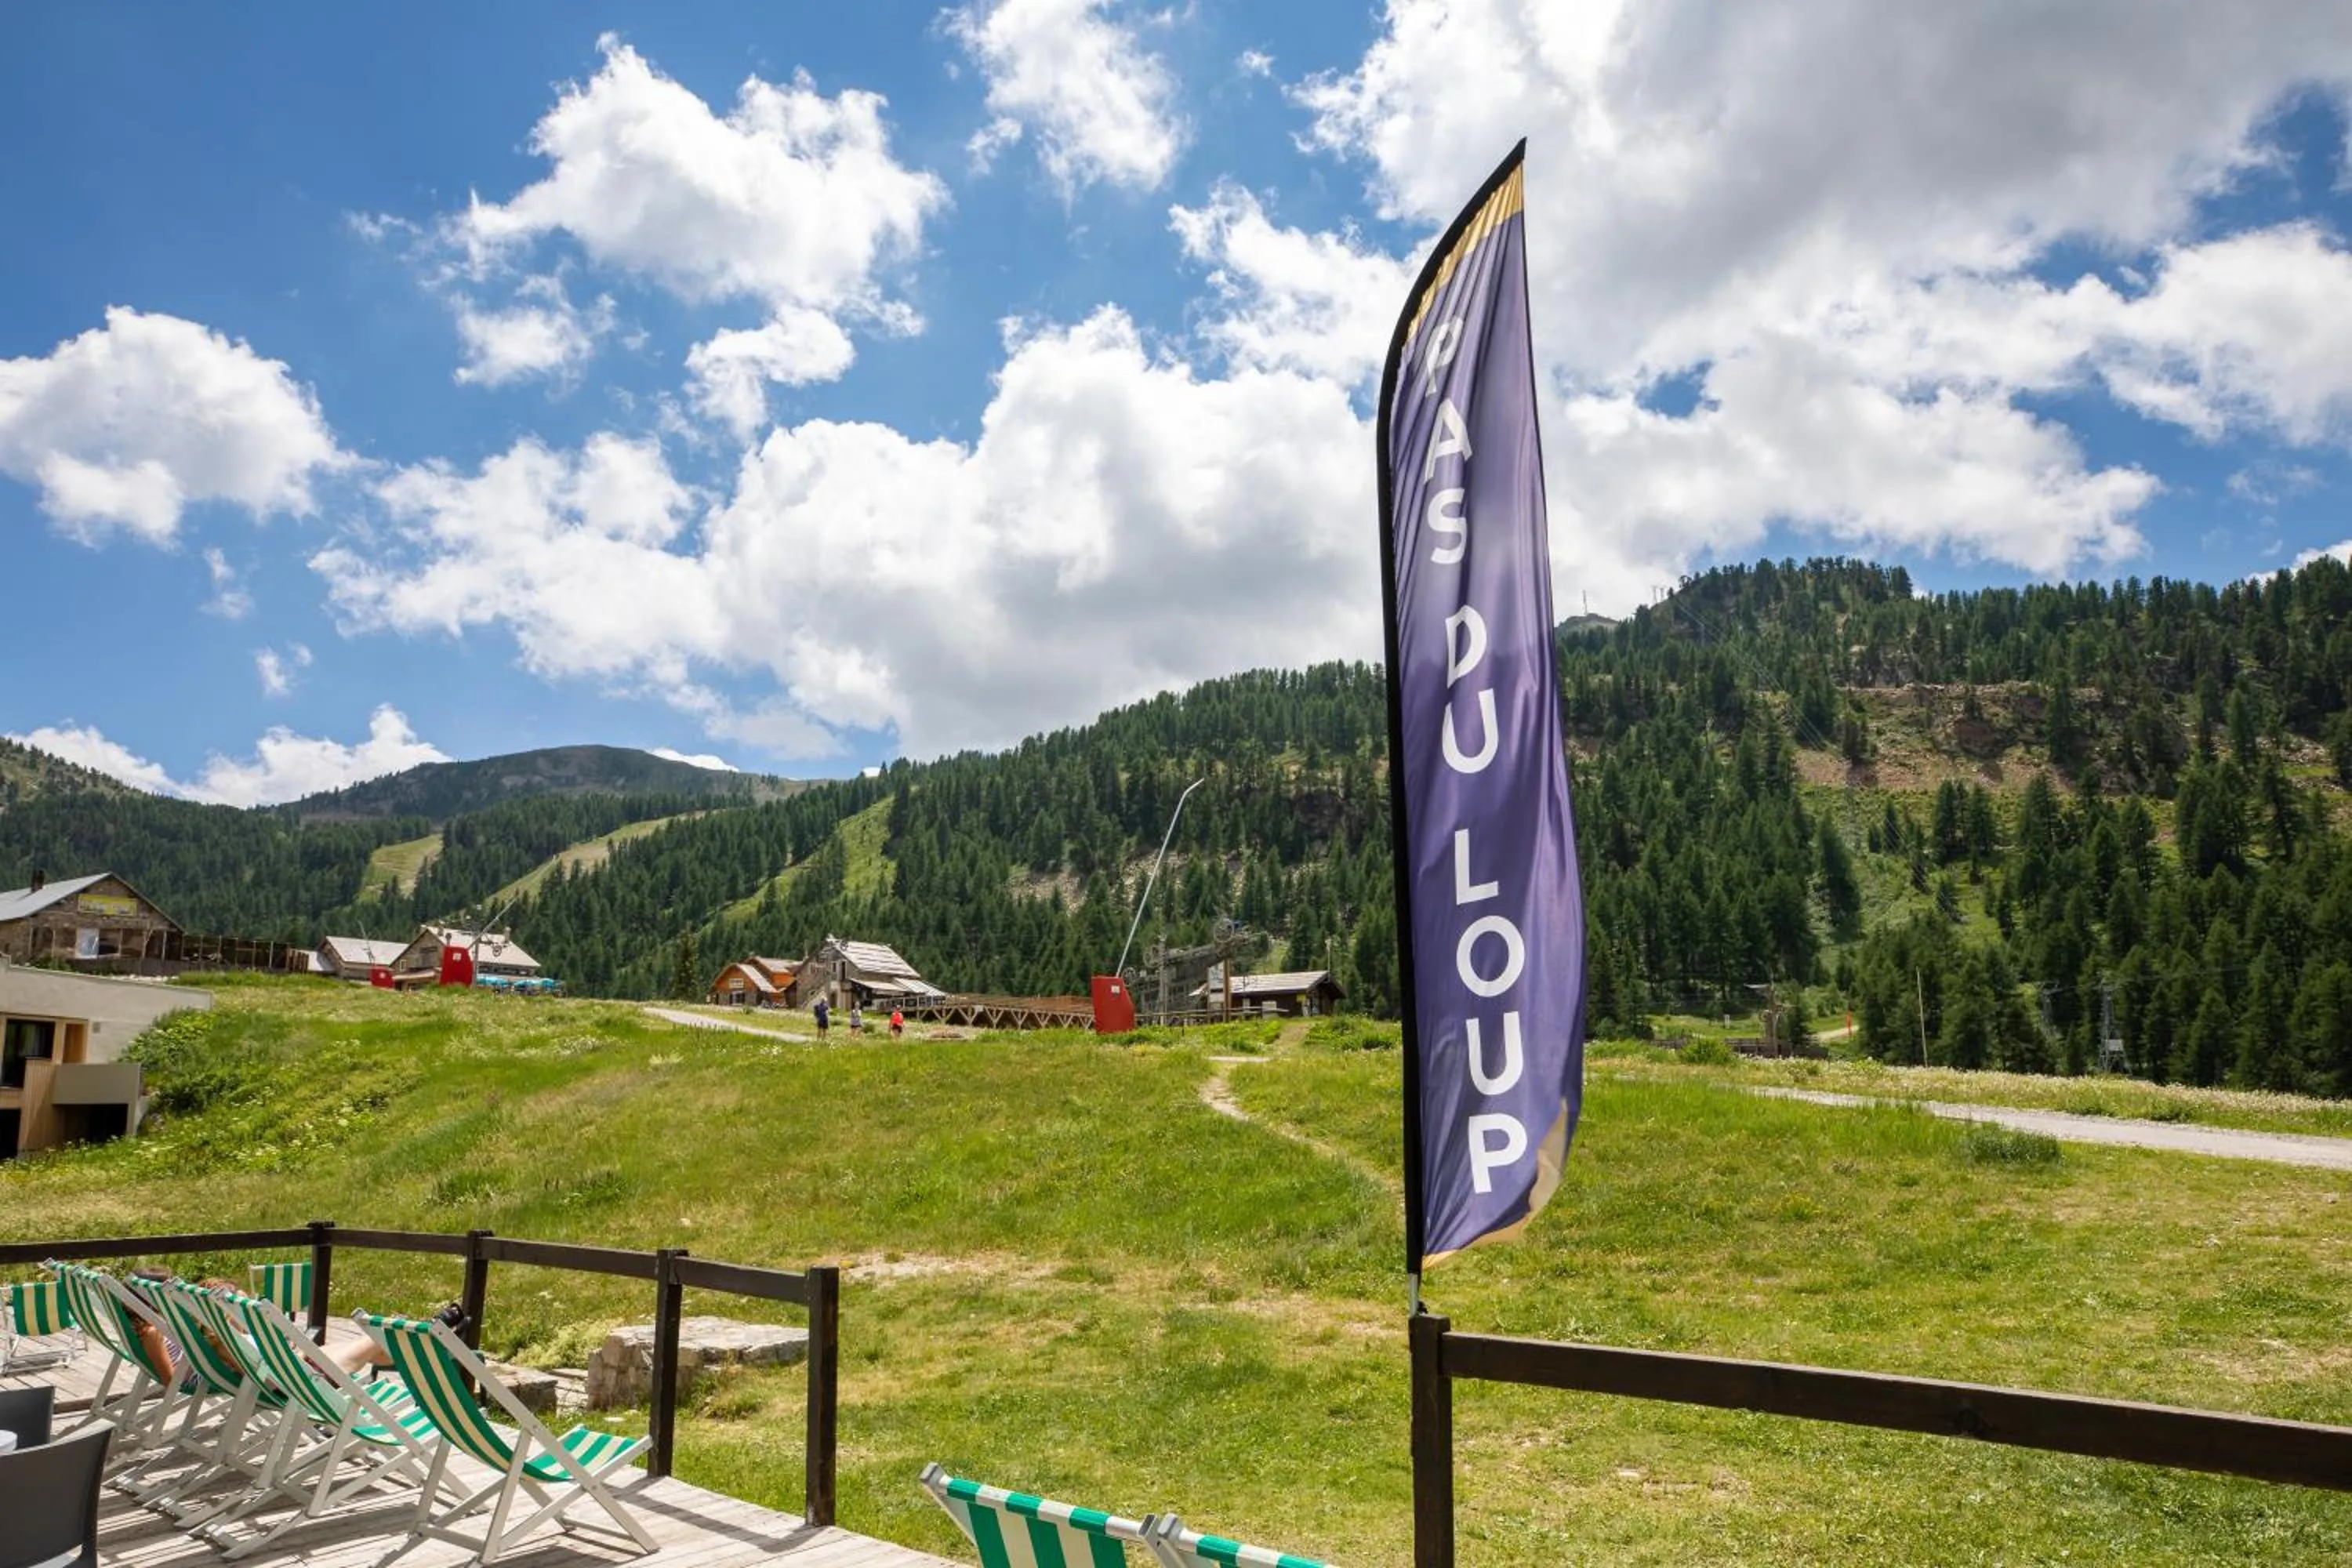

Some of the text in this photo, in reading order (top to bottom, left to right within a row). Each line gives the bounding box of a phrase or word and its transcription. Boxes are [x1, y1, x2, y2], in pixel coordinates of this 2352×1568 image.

[1425, 315, 1527, 1194] PAS DU LOUP
